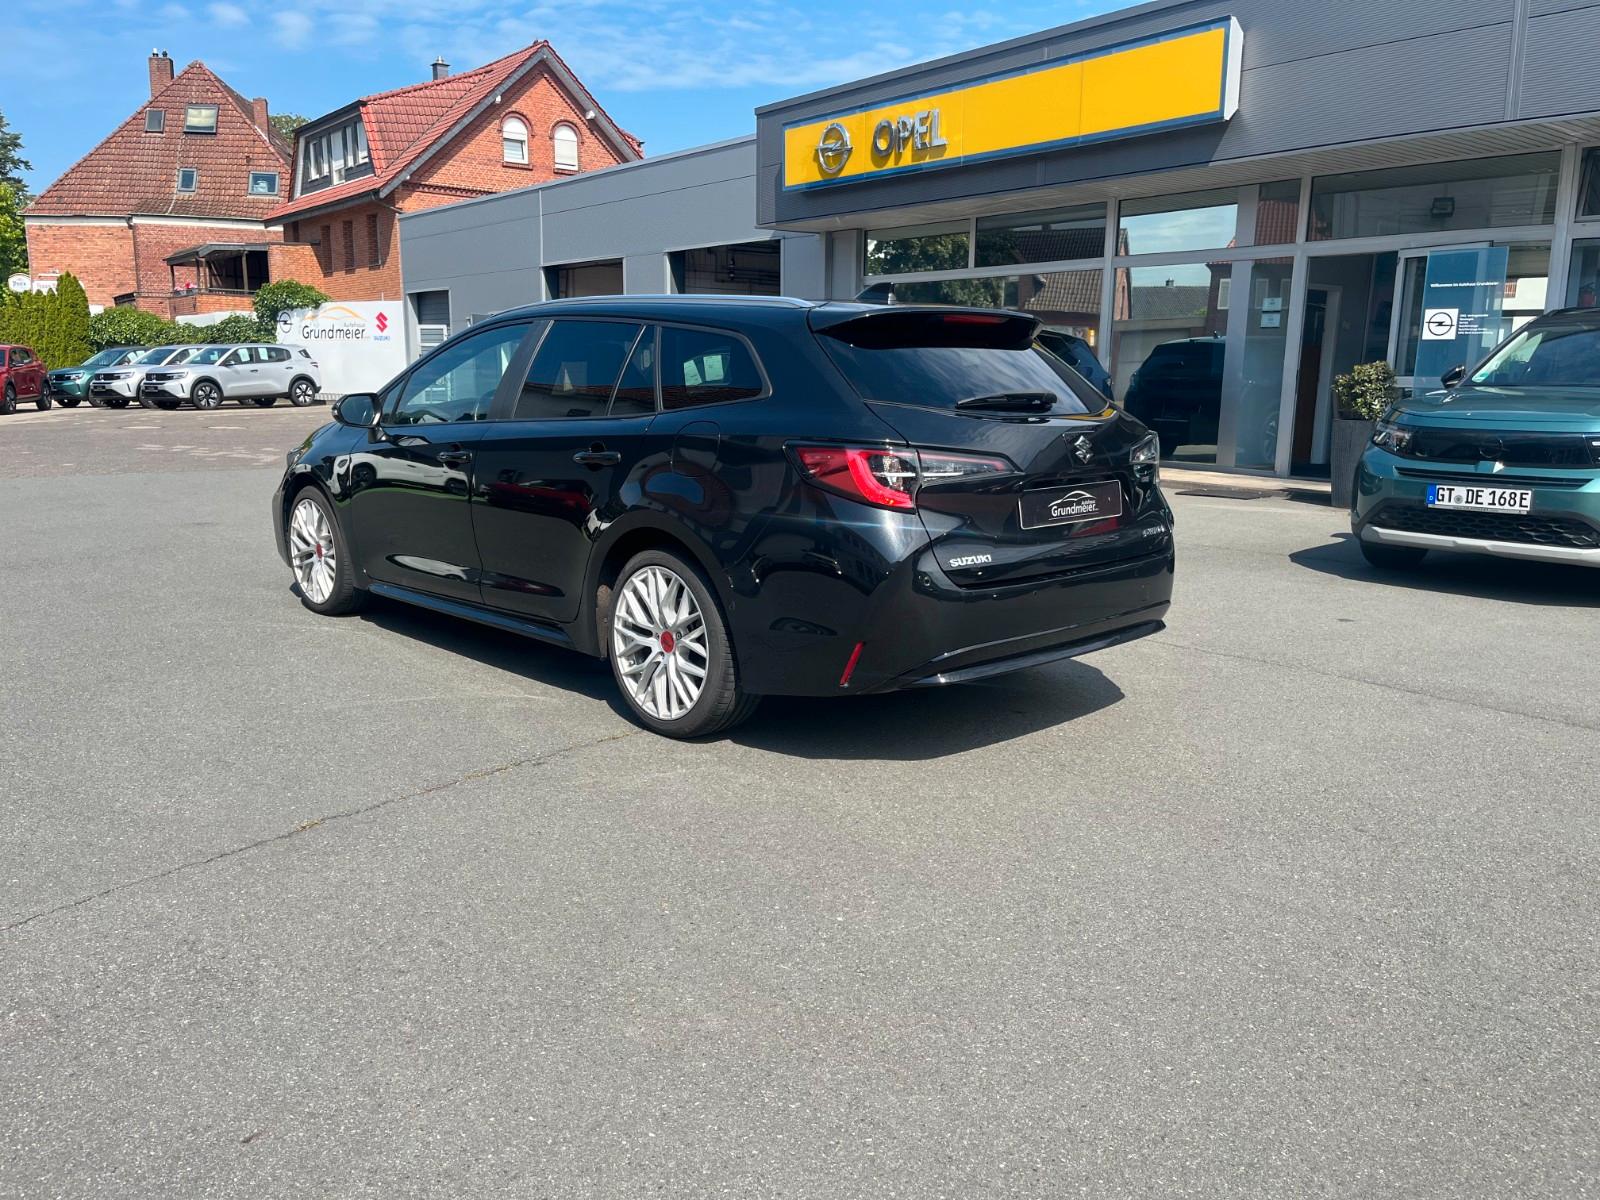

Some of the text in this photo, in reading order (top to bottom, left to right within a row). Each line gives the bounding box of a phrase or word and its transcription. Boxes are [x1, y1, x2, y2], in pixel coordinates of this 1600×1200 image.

[873, 108, 948, 157] OPEL
[302, 315, 365, 340] Grundmeier
[1436, 487, 1530, 508] GT DE 168E
[1051, 502, 1096, 517] Grundmeier
[949, 554, 992, 567] SUZUKI
